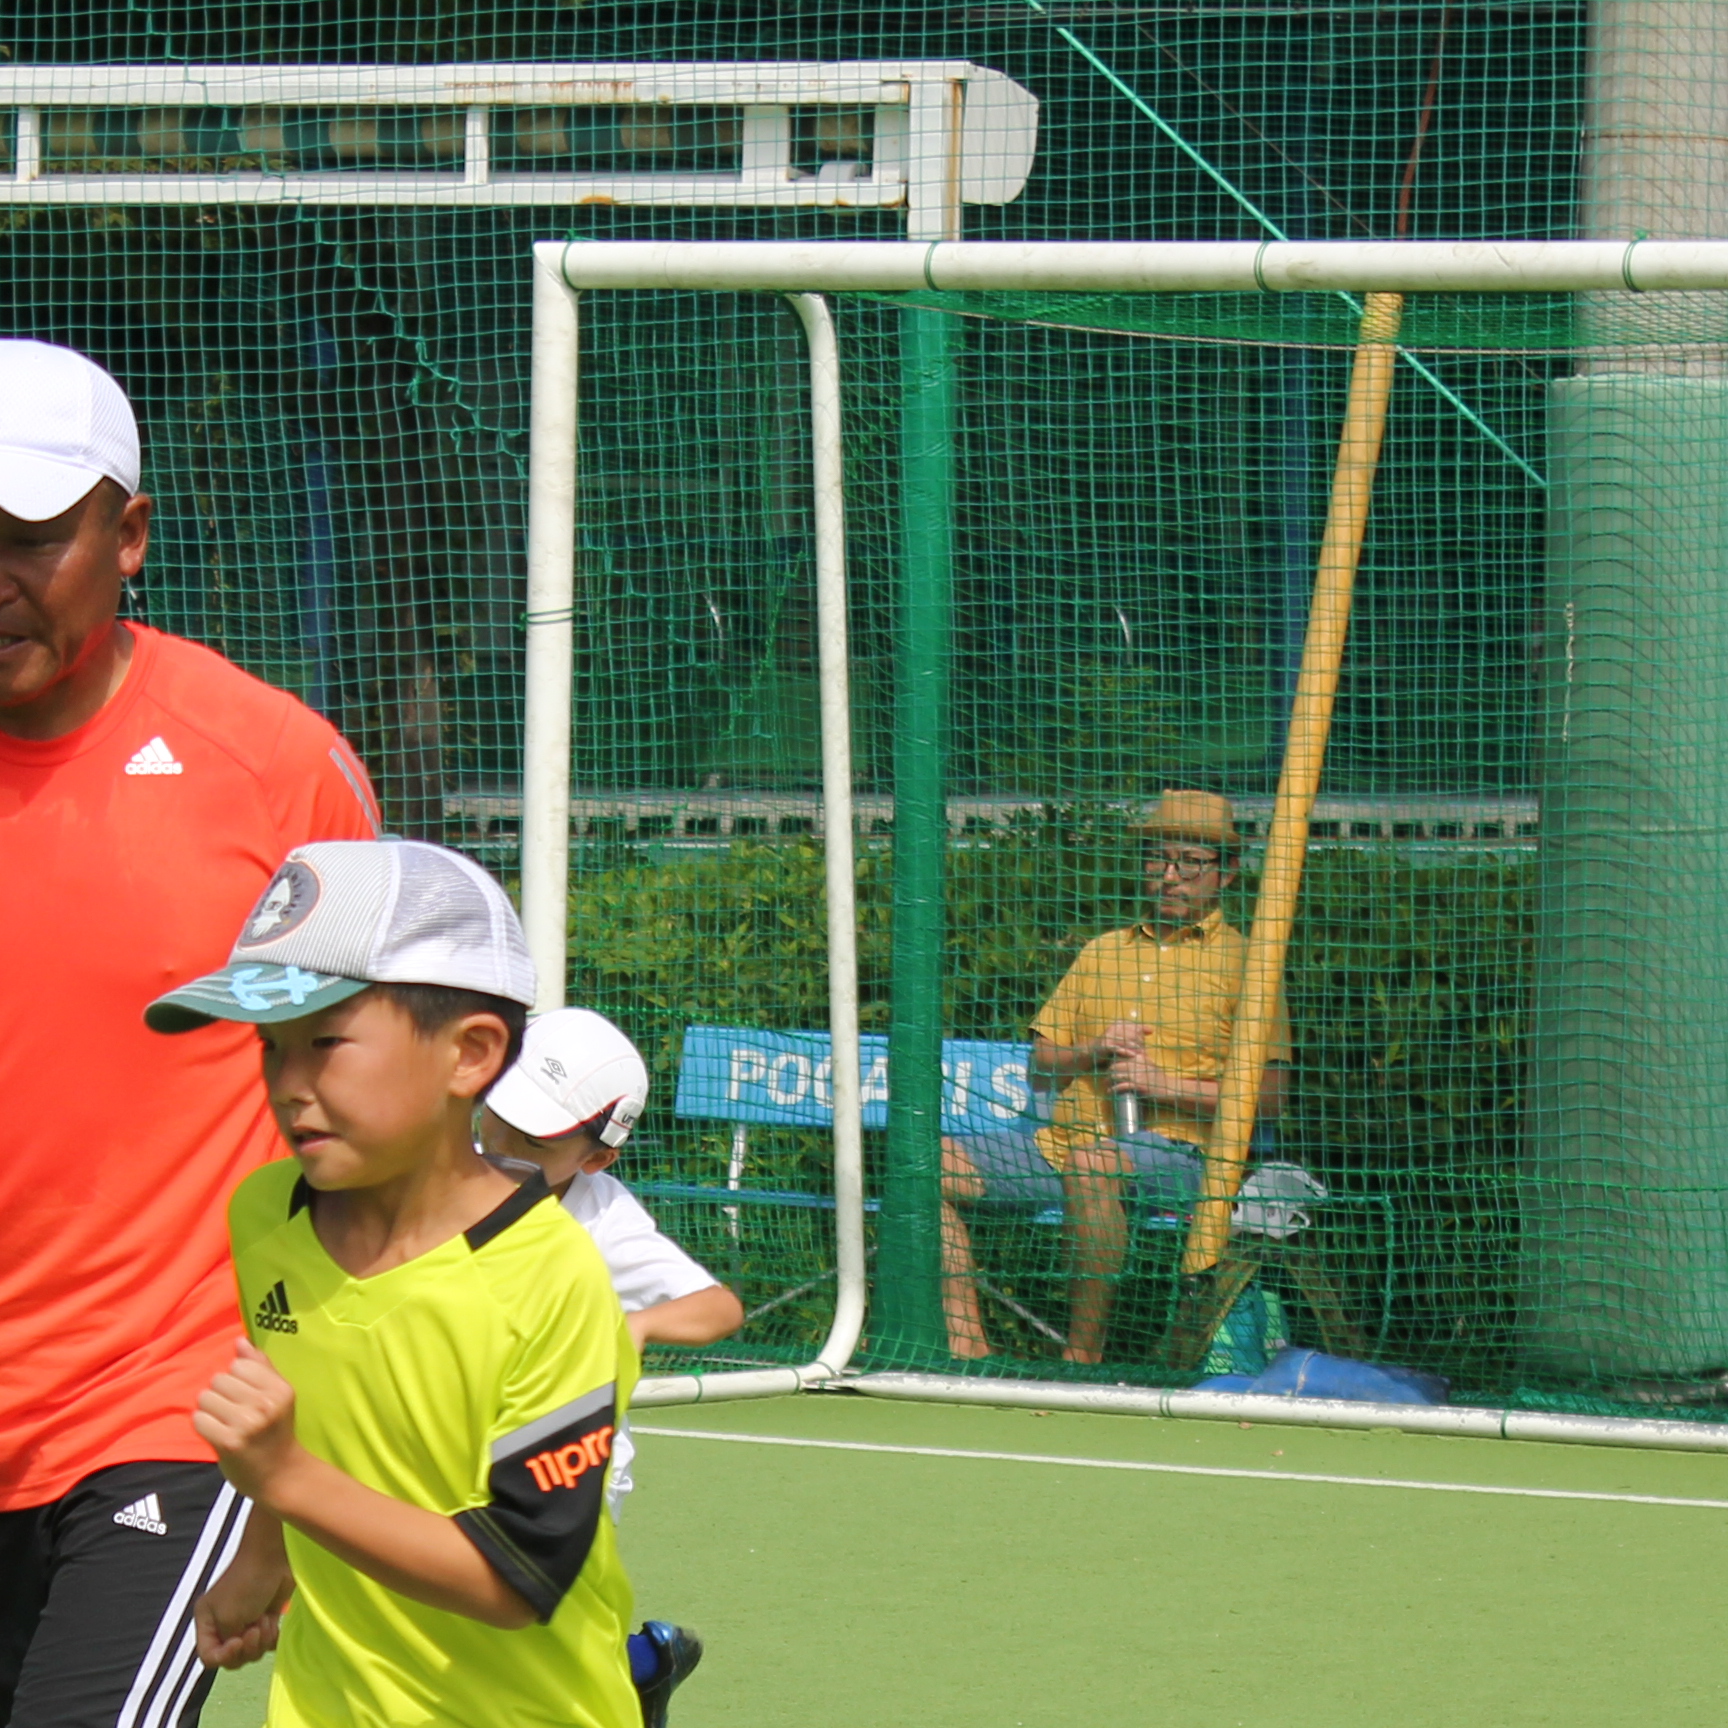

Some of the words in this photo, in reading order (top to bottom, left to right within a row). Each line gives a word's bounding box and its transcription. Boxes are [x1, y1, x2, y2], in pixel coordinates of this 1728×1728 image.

[125, 760, 183, 775] adidas
[255, 1312, 298, 1335] adidas
[113, 1511, 168, 1536] adidas
